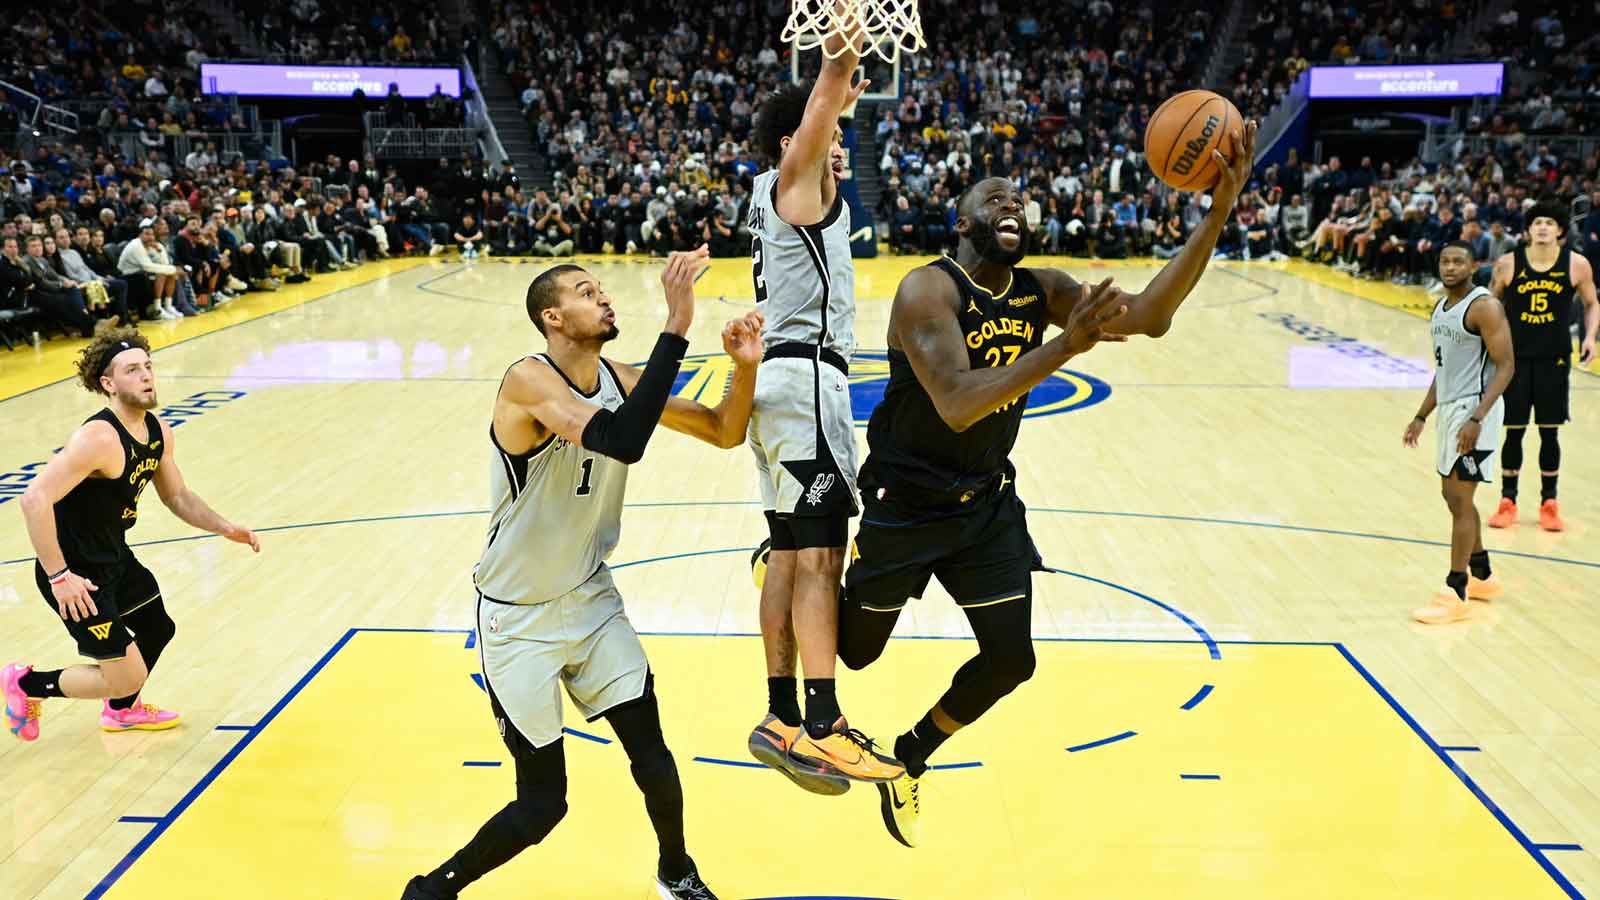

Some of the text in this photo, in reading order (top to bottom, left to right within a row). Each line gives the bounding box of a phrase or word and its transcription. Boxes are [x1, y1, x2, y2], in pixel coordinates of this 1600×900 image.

[1380, 79, 1458, 93] accenture
[1172, 115, 1219, 176] Wilson
[1517, 280, 1563, 294] GOLDEN
[1008, 294, 1038, 307] Rakuten
[1530, 292, 1548, 312] 15
[1520, 312, 1554, 324] STATE
[966, 317, 1034, 349] GOLDEN
[1435, 345, 1443, 367] 4
[575, 457, 595, 496] 1
